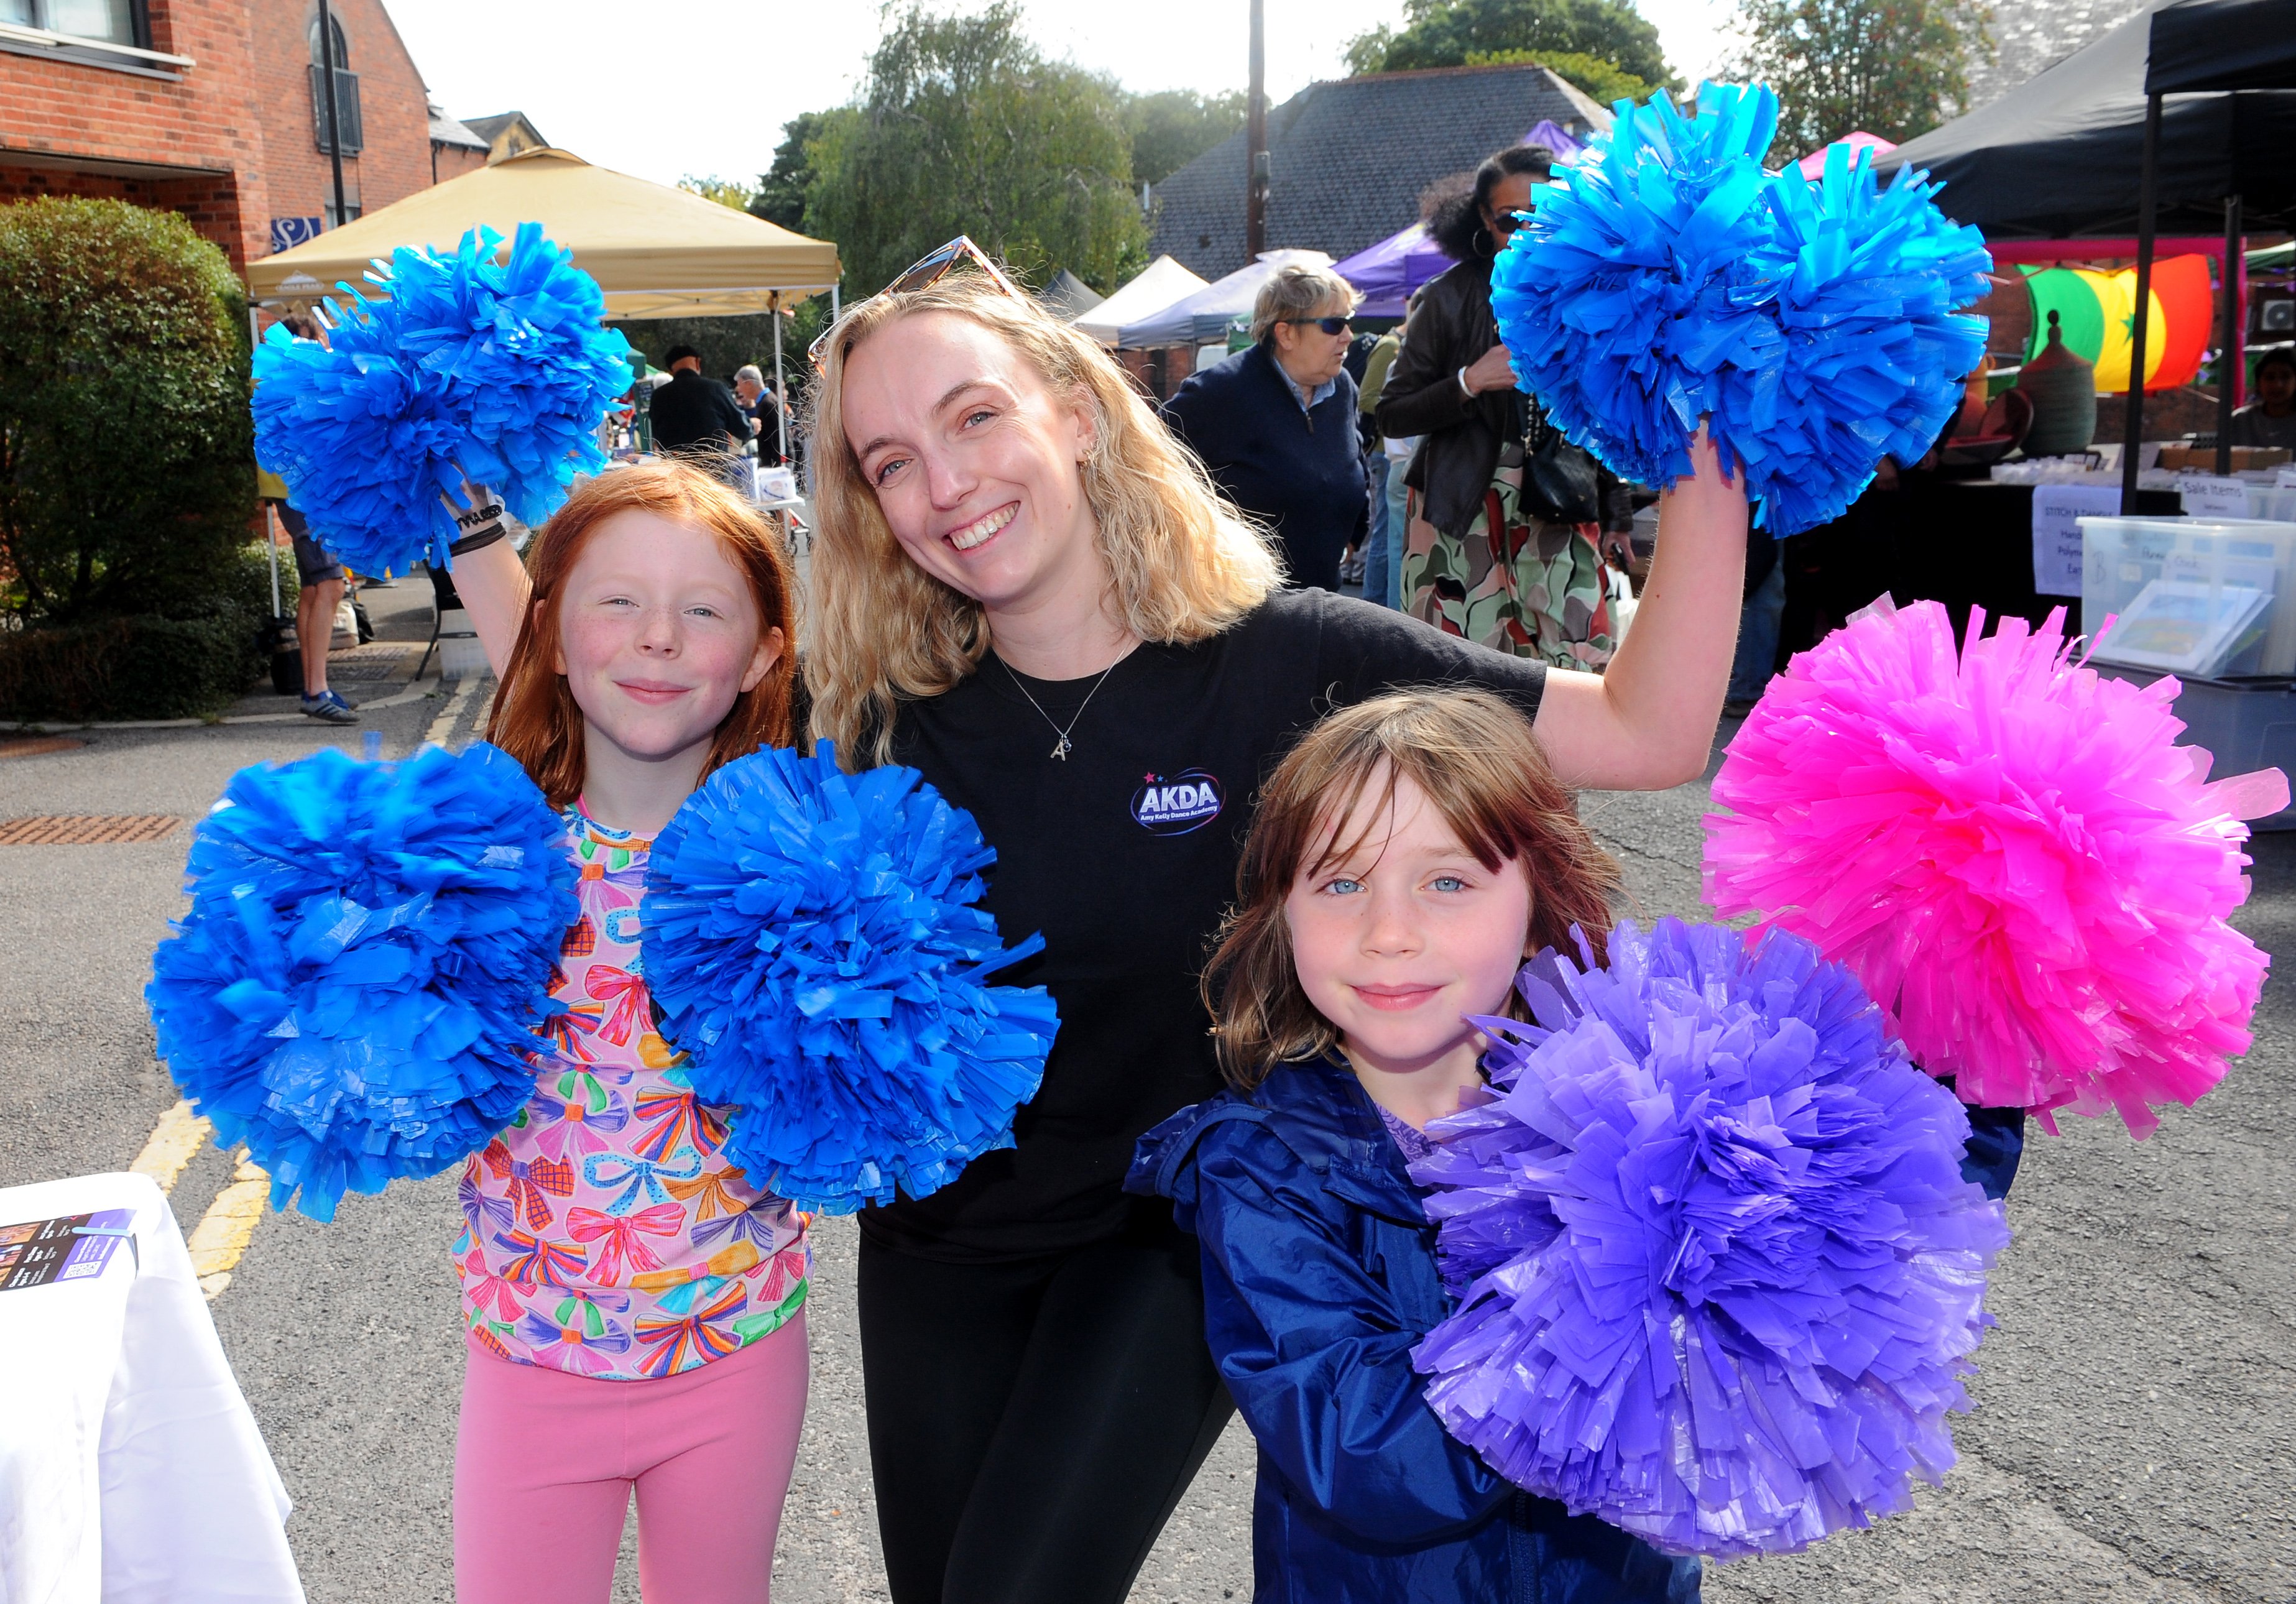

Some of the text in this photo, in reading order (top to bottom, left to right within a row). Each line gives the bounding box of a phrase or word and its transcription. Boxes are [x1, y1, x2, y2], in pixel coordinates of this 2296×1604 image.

[2183, 482, 2243, 497] Sale Items
[1140, 782, 1217, 813] AKDA
[1191, 805, 1218, 816] Academy
